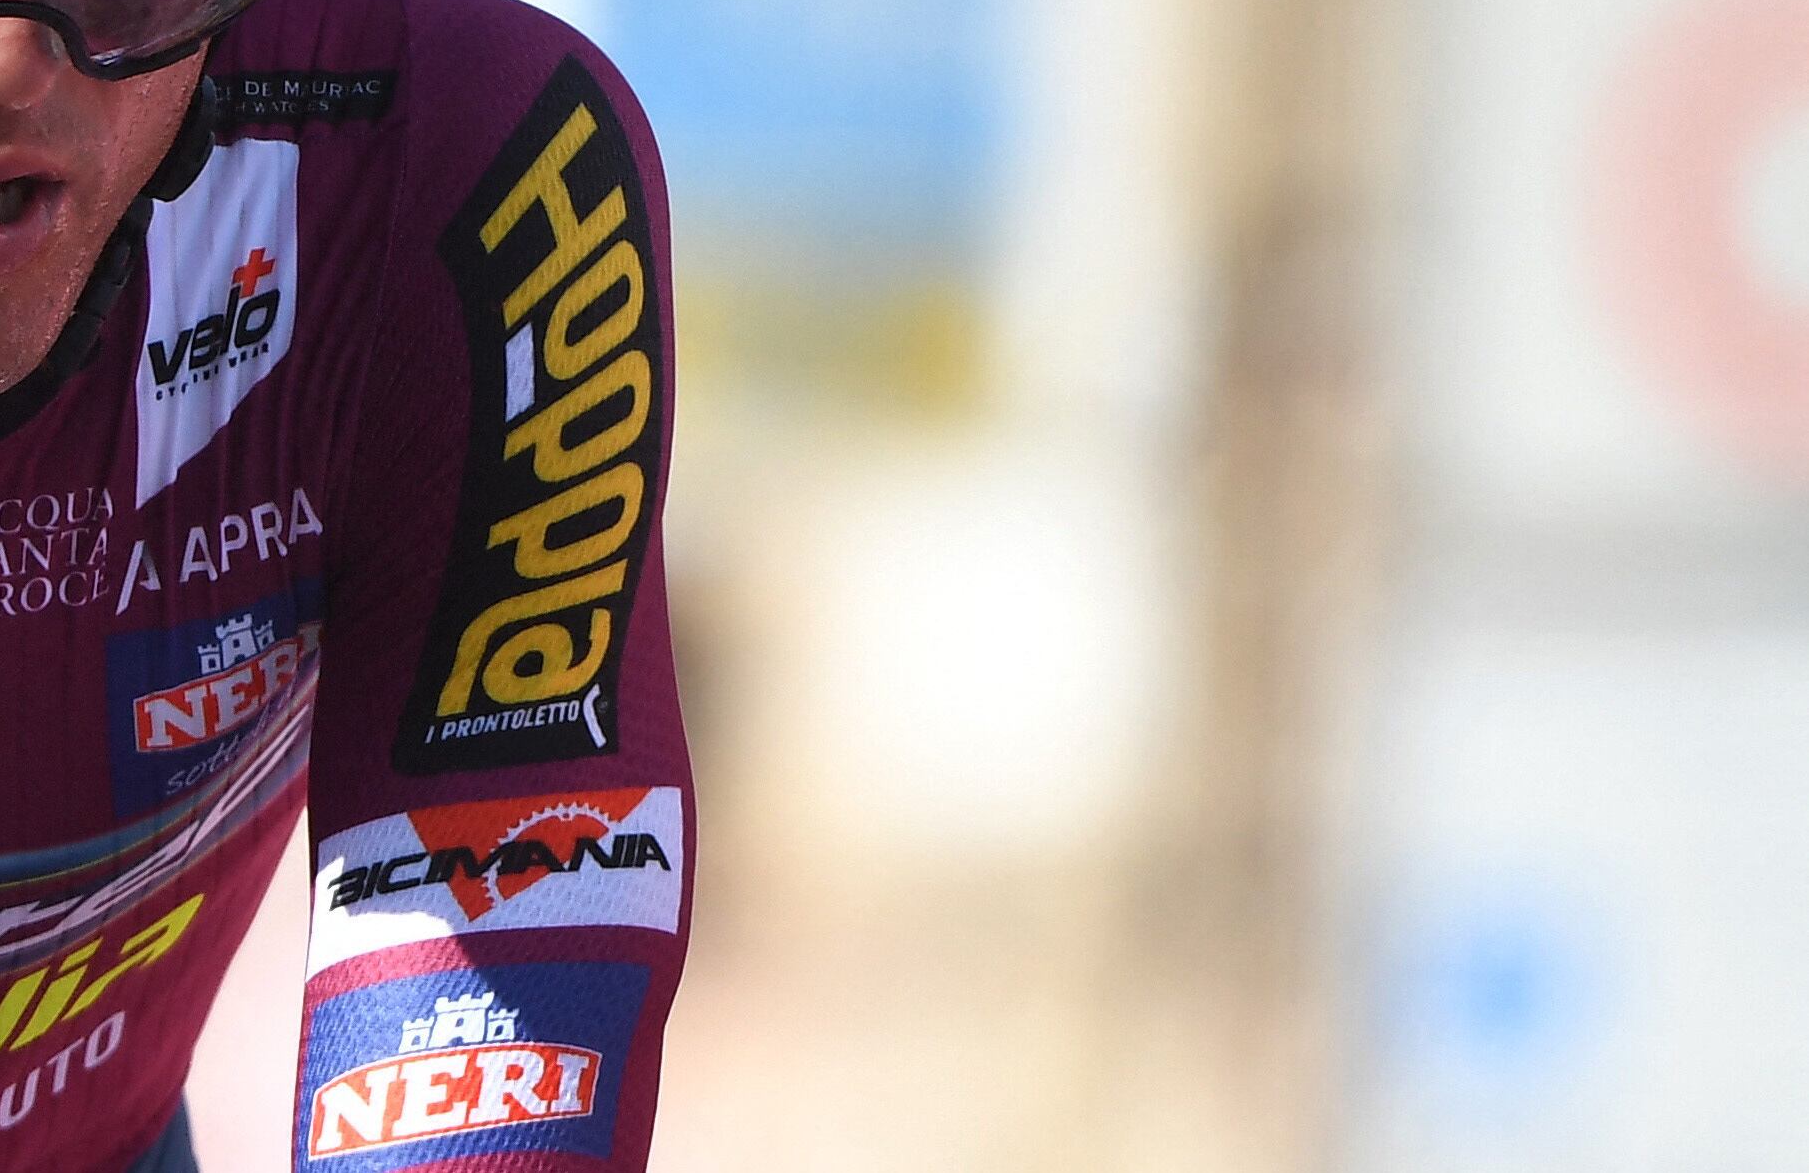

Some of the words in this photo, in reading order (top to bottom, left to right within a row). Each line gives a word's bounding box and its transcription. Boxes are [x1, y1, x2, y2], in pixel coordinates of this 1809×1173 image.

[244, 80, 272, 97] DE
[284, 79, 381, 100] MURAC
[179, 487, 324, 584] APRA
[441, 699, 581, 741] PRONTOLETTO
[327, 832, 672, 912] BICIMANIA
[316, 1052, 590, 1152] NERI
